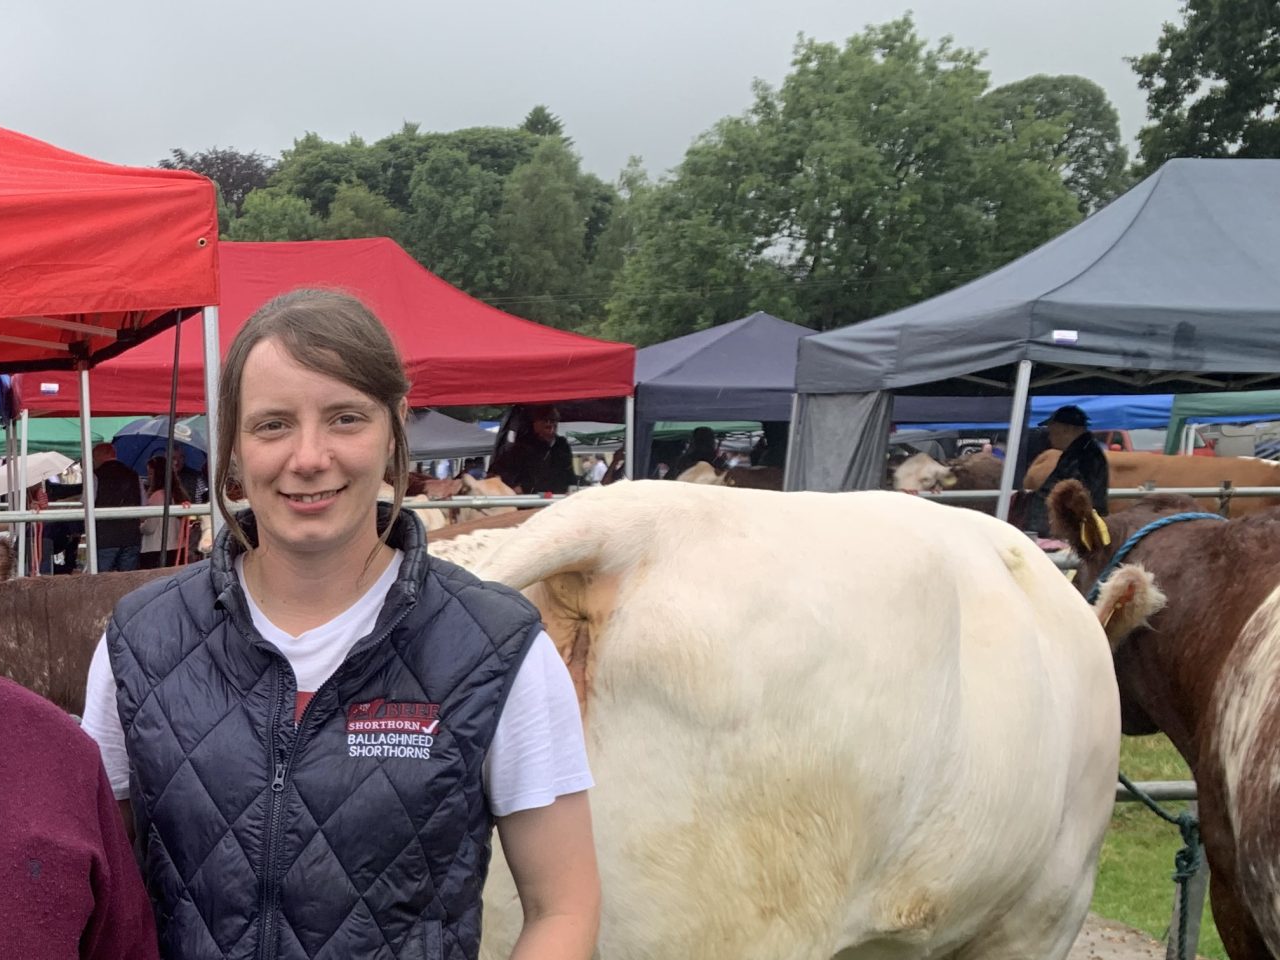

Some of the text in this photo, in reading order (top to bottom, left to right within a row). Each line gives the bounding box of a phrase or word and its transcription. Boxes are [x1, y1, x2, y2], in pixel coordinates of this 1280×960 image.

[385, 703, 440, 718] BEEF
[348, 720, 420, 731] SHORTHORN
[347, 733, 433, 747] BALLAGHNEED
[349, 746, 430, 759] SHORTHORNS
